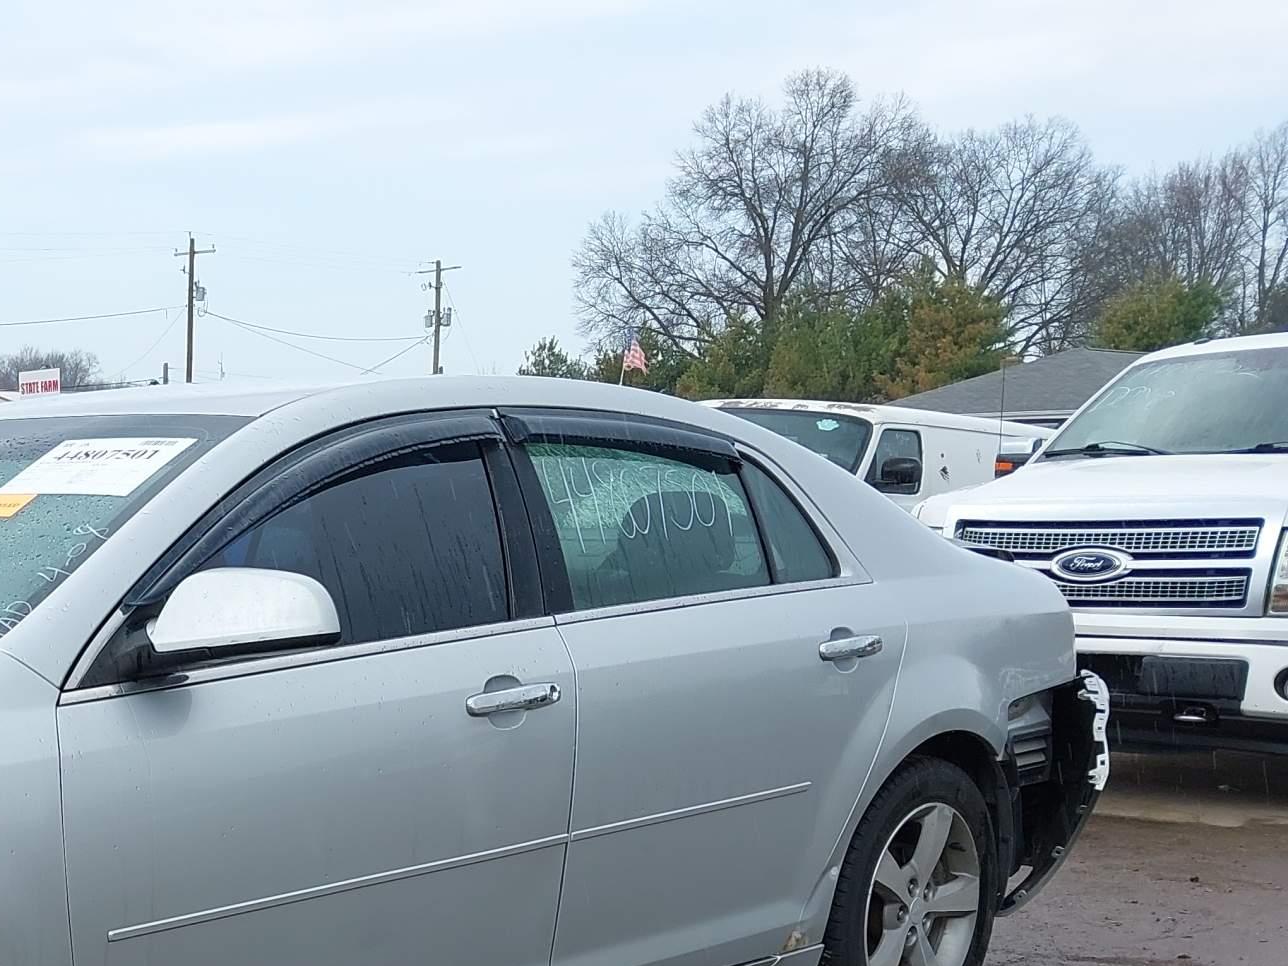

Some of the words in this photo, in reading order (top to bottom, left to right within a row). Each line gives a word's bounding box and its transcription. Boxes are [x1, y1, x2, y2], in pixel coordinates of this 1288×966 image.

[21, 381, 39, 395] STATE
[40, 379, 59, 393] FARM
[1069, 556, 1105, 570] Ford
